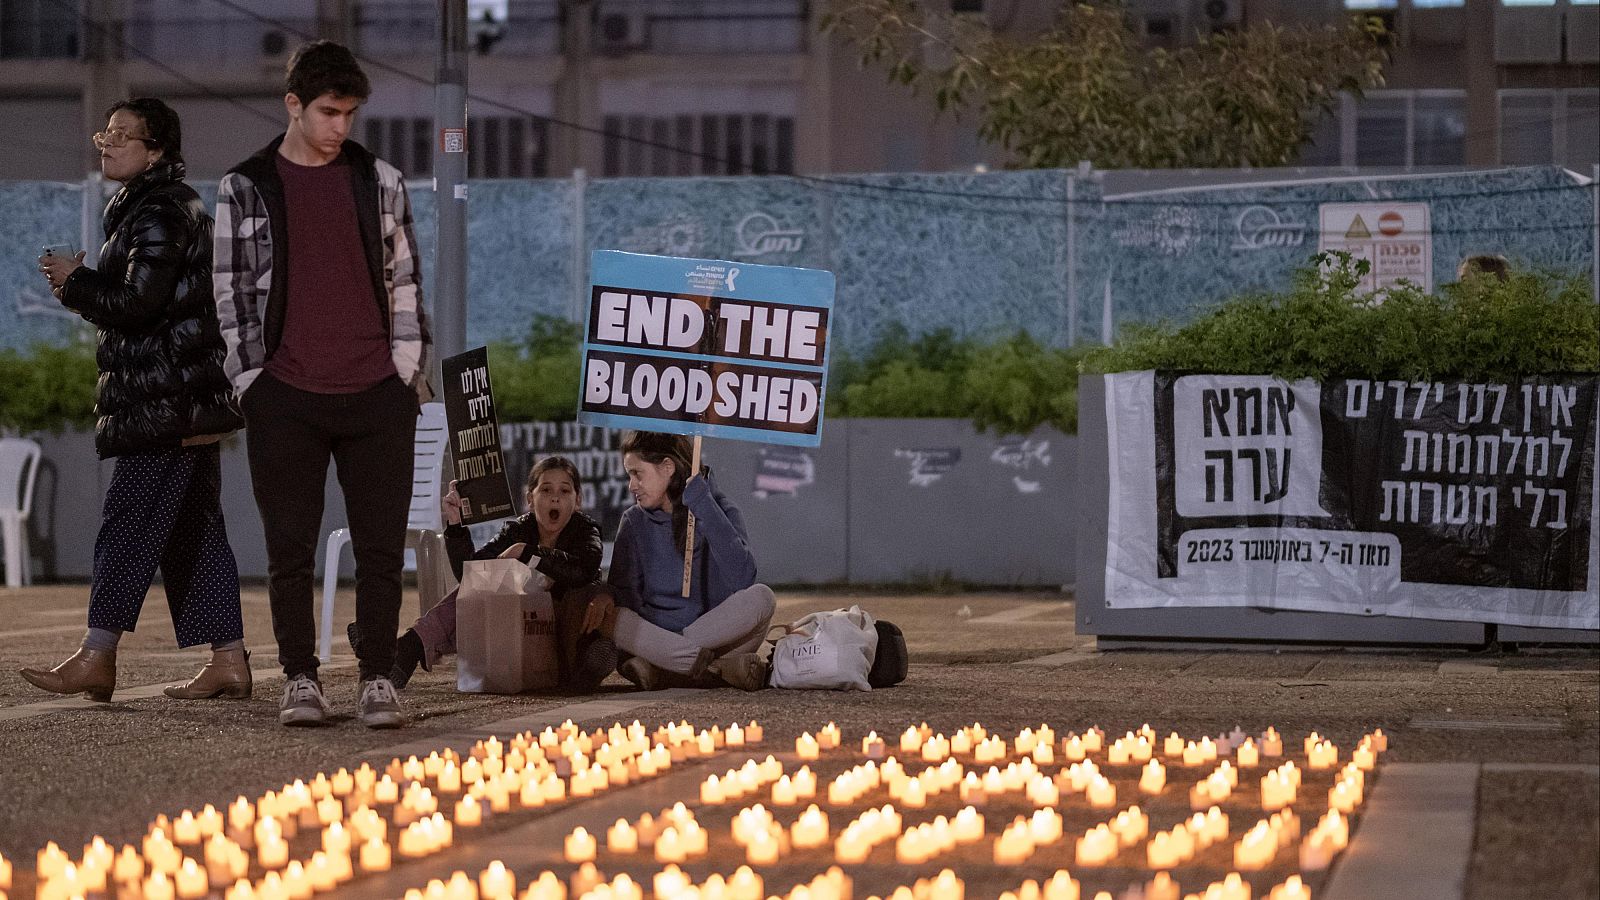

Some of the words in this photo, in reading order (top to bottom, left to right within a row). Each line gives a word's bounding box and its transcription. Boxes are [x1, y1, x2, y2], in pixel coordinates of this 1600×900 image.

[597, 291, 705, 348] END
[720, 303, 820, 361] THE
[460, 367, 474, 394] לנו
[474, 366, 488, 394] אין
[585, 358, 818, 424] BLOODSHED
[1345, 379, 1445, 420] ילדים
[468, 392, 491, 421] ילדים
[1202, 386, 1295, 438] אמא
[1457, 383, 1508, 424] לנו
[1520, 383, 1577, 433] אין
[458, 420, 496, 453] למלחמות
[1401, 428, 1573, 478] למלחמות
[458, 455, 486, 481] מטרות
[485, 450, 502, 474] בלי
[1204, 447, 1292, 505] ערה
[1379, 480, 1498, 527] מטרות
[1512, 480, 1568, 529] בלי
[1187, 538, 1234, 564] 2023
[1239, 540, 1313, 564] באוקטובר
[1359, 543, 1391, 567] מאז
